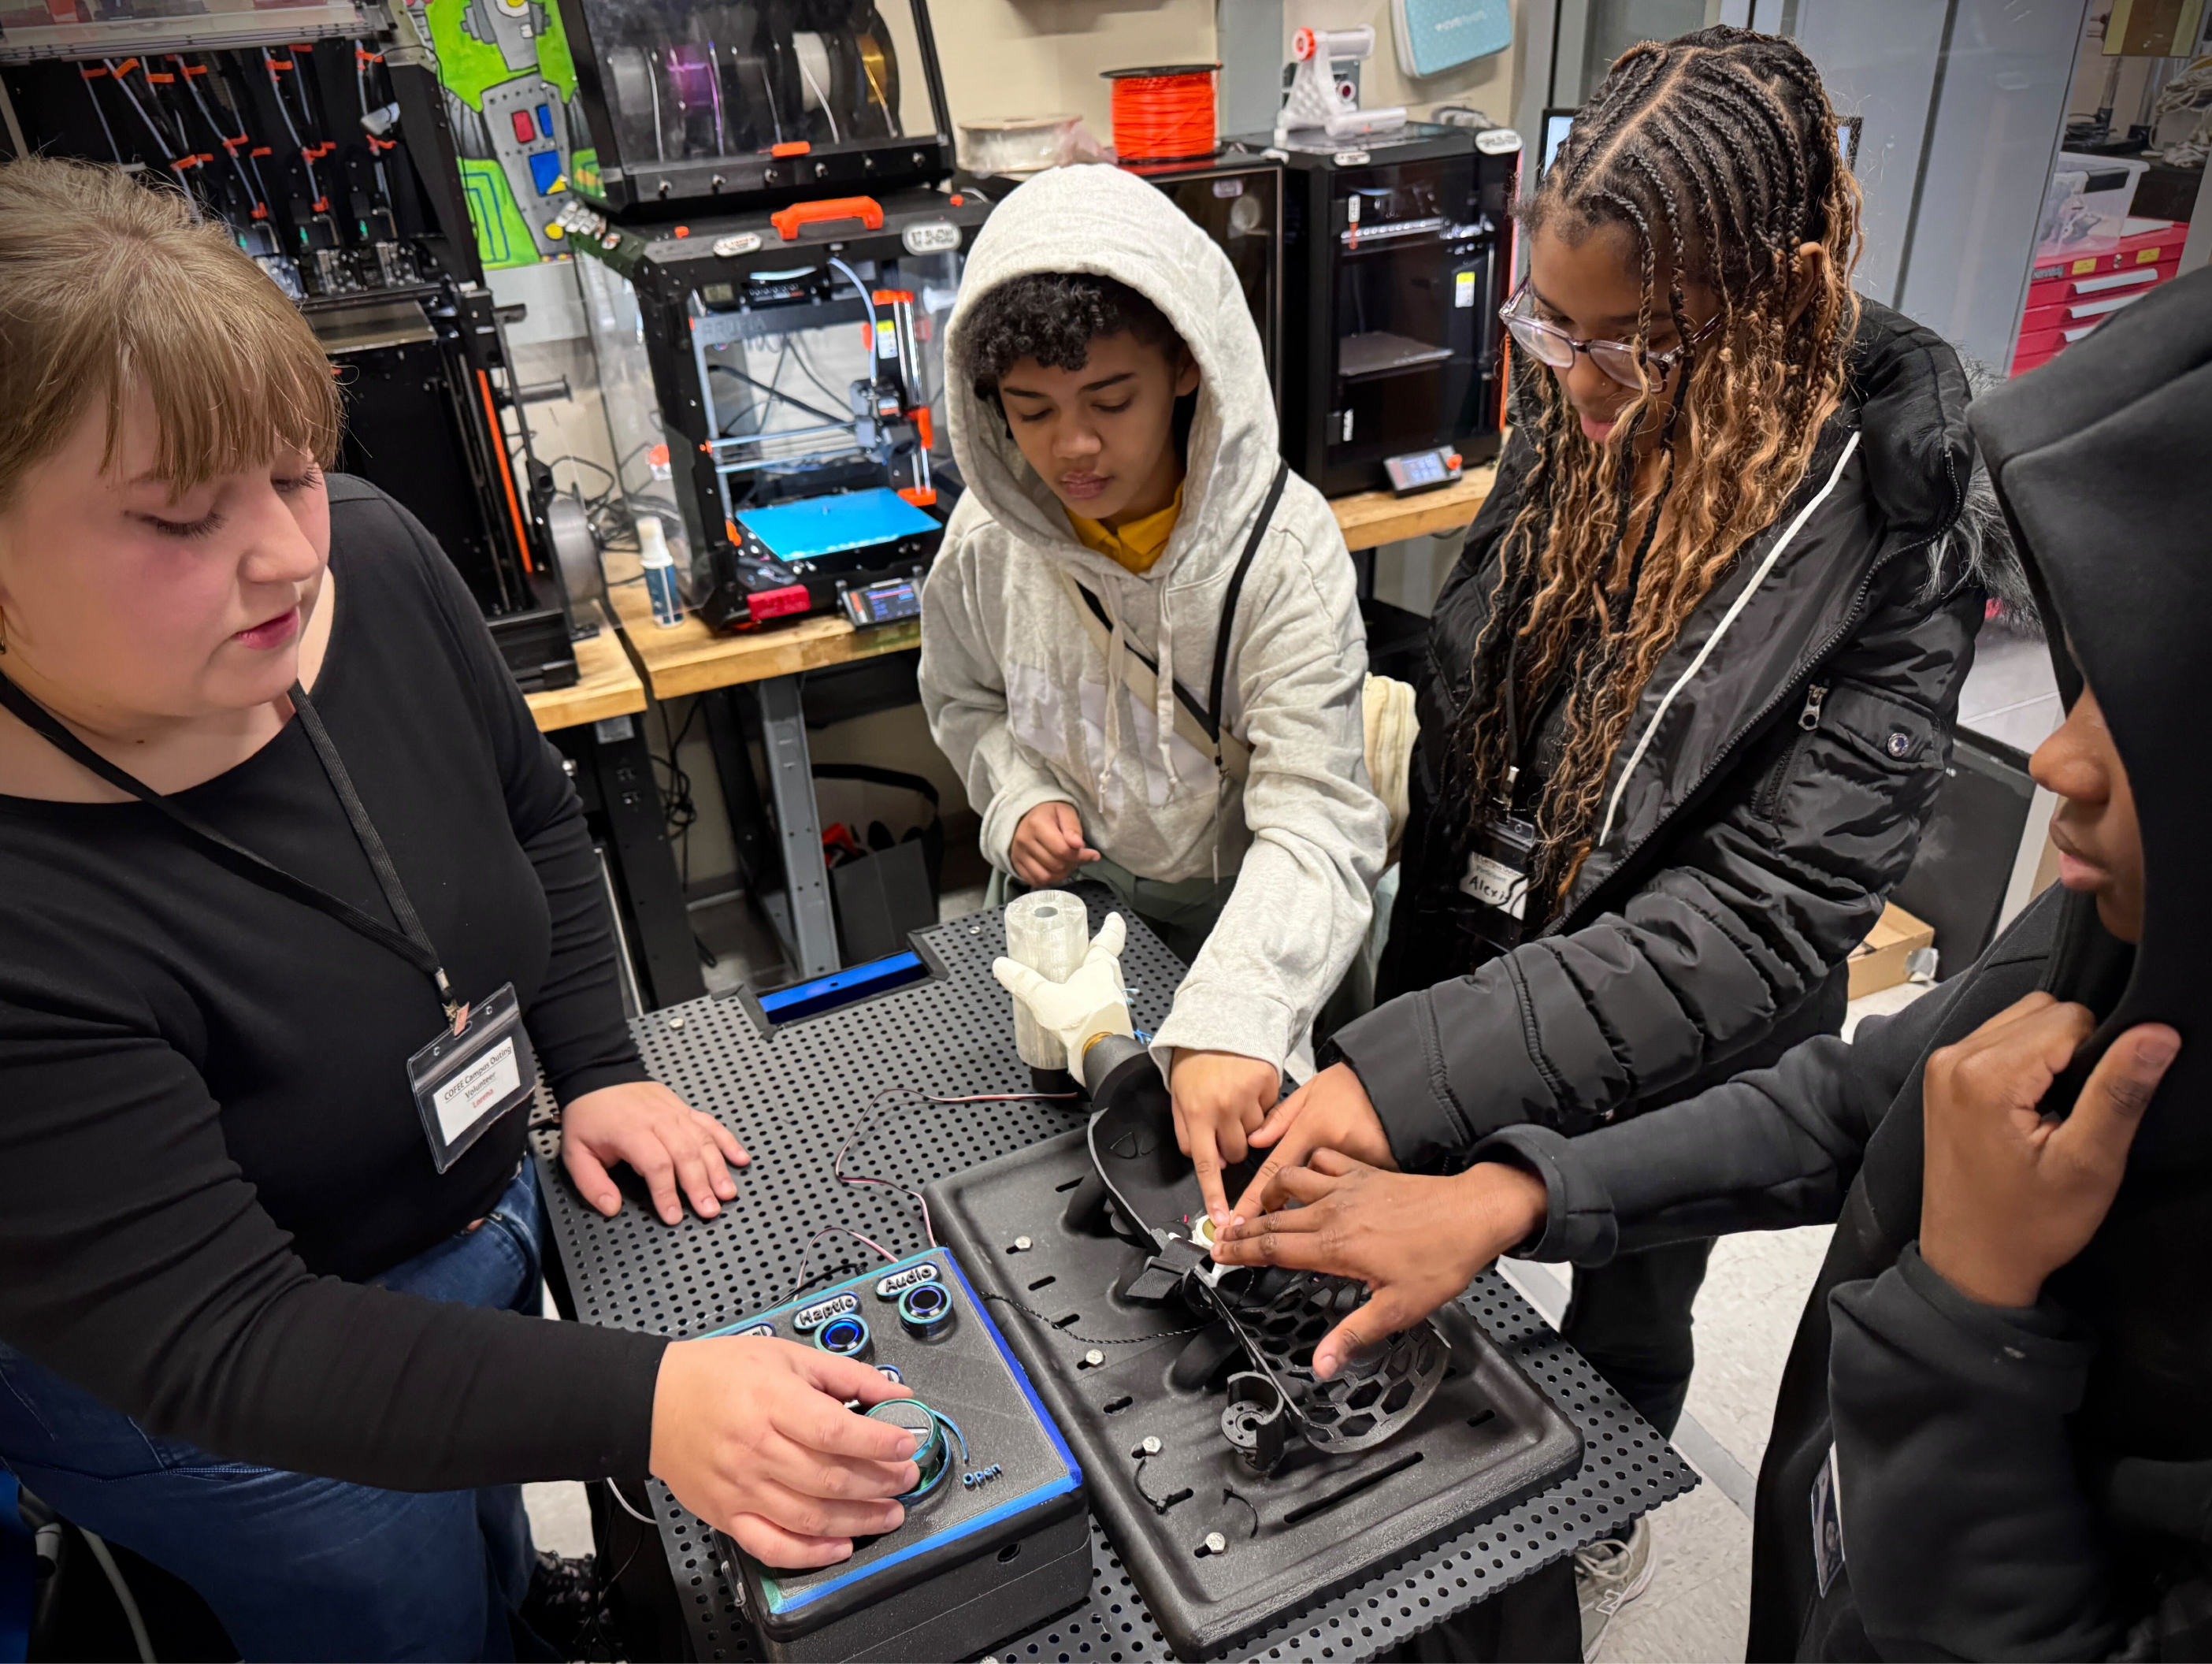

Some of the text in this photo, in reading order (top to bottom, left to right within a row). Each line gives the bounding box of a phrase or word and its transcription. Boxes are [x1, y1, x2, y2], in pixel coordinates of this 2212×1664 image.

[1468, 875, 1508, 901] Alexi
[444, 1046, 512, 1101] COFEE Campus Outing
[465, 1072, 496, 1099] Volunteer
[472, 1088, 494, 1109] Lorena
[885, 1264, 932, 1293] Audio
[798, 1297, 854, 1326] Haptic
[963, 1463, 1002, 1487] Open
